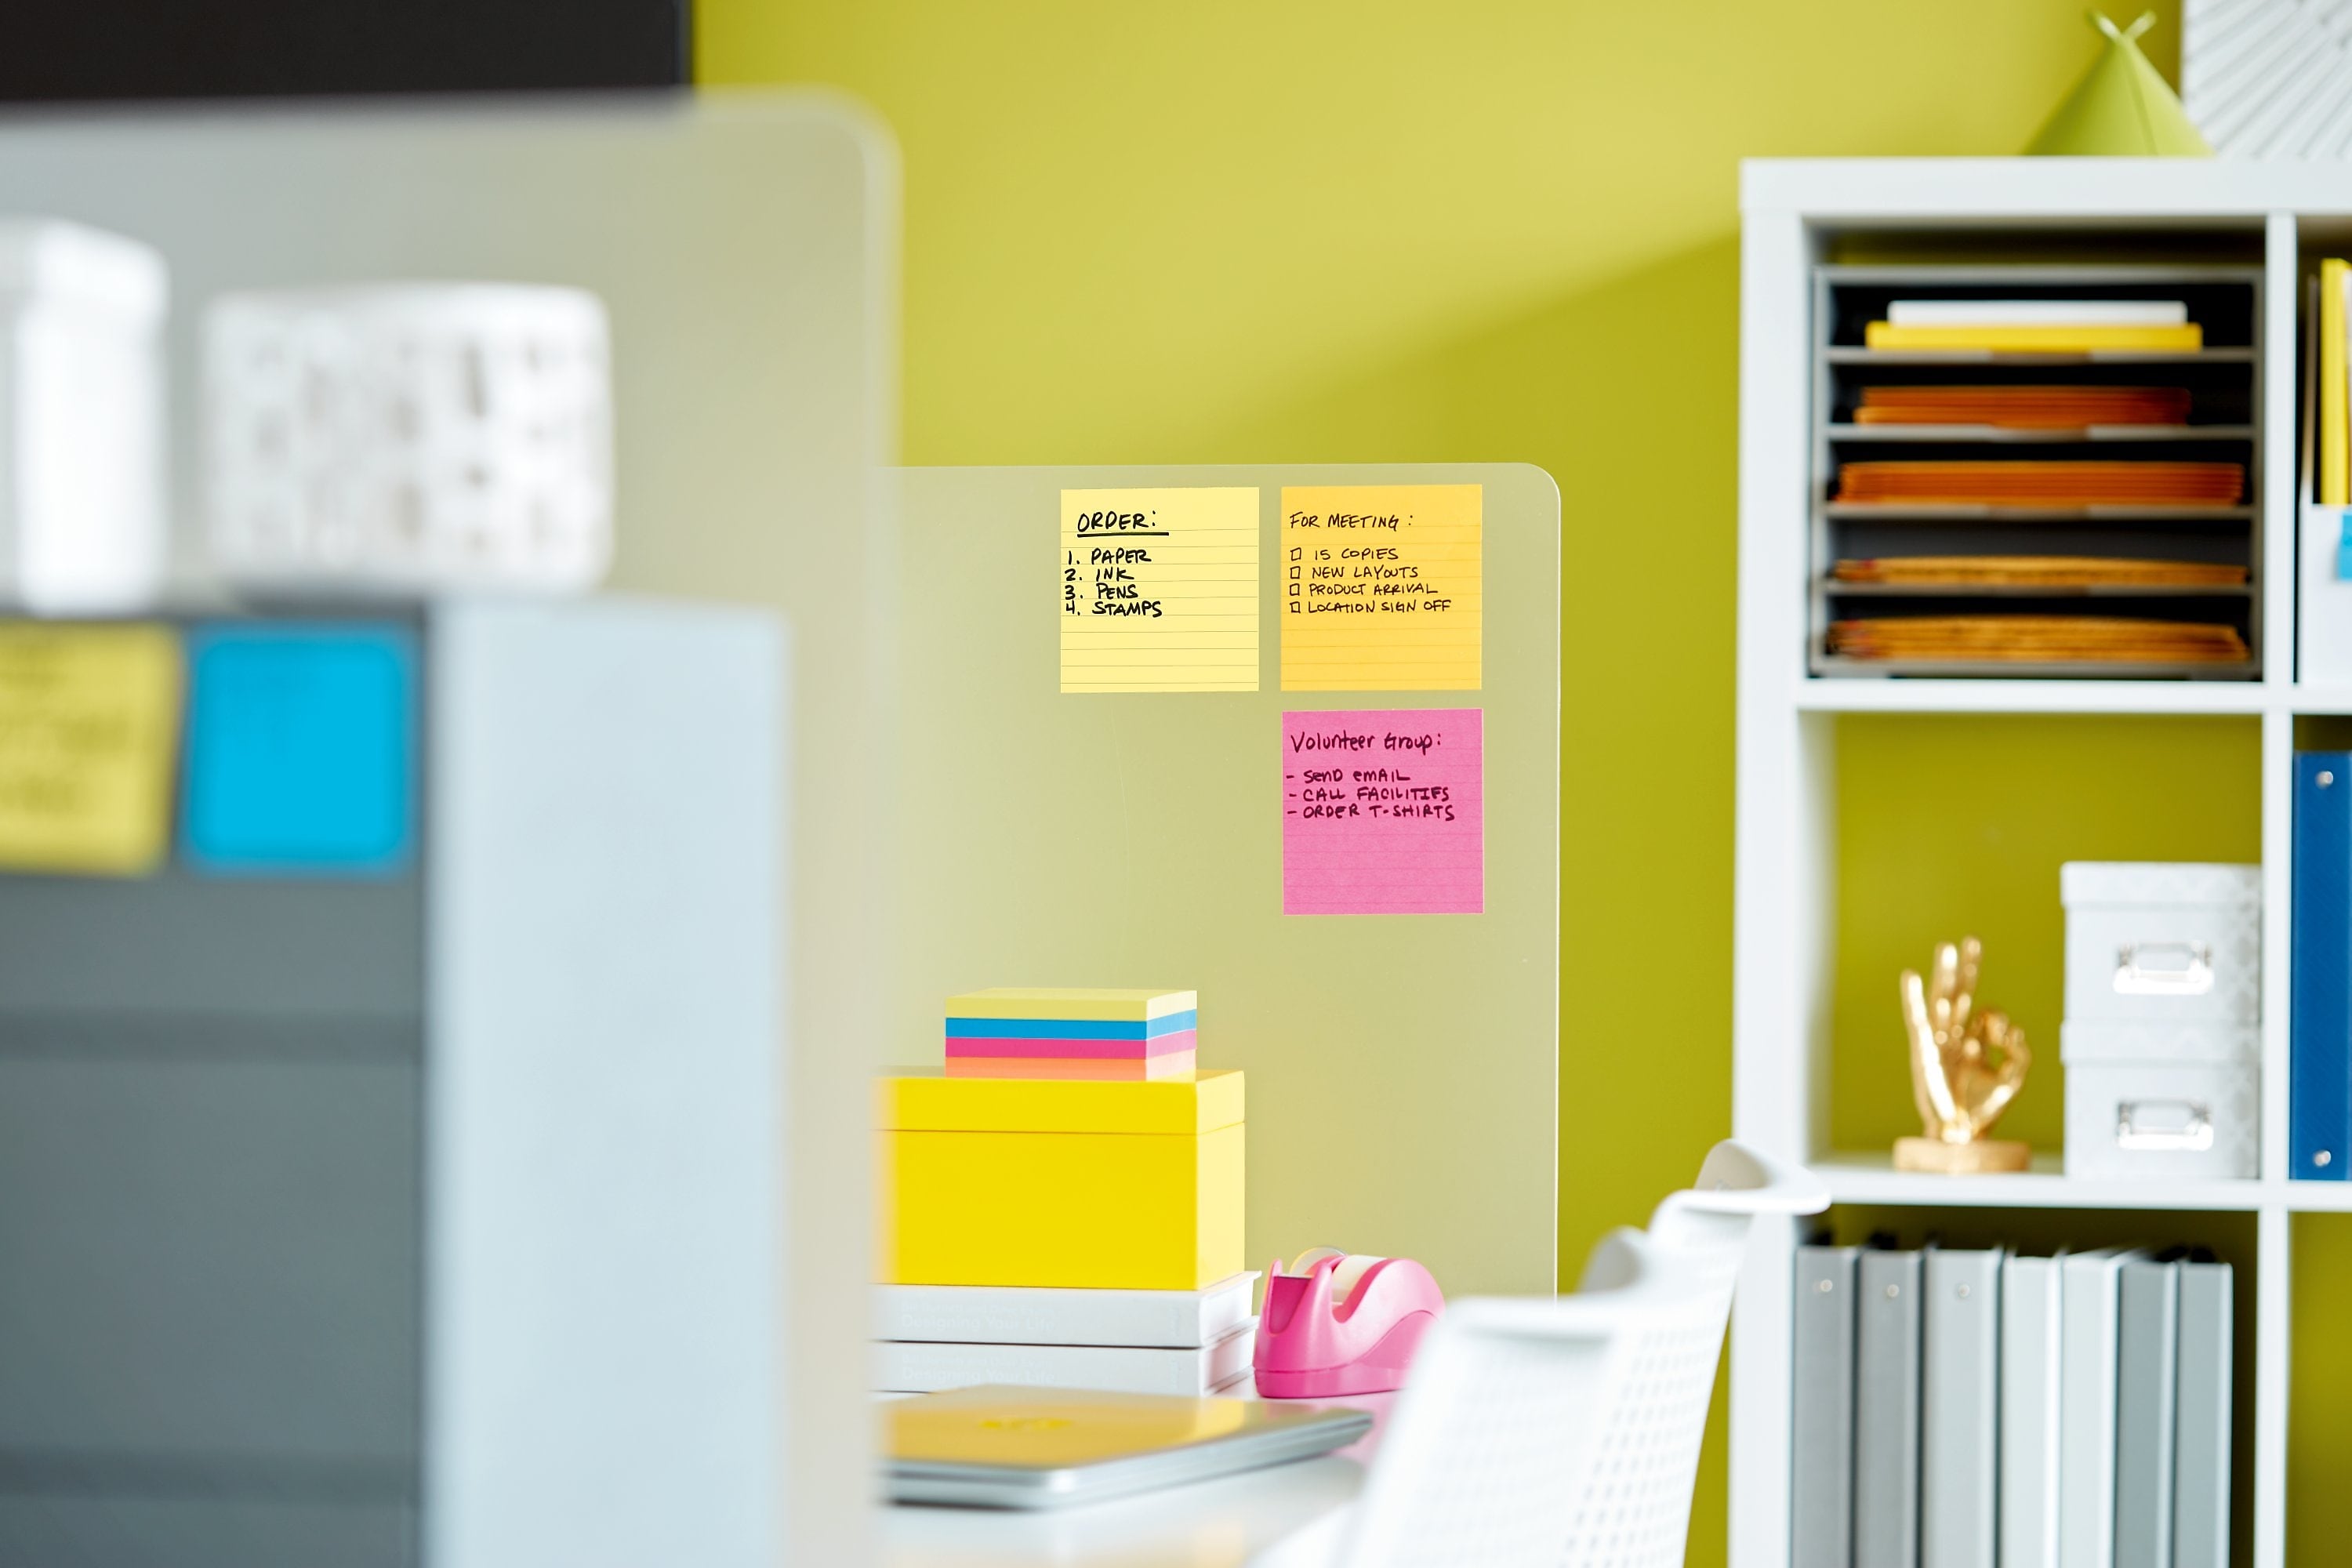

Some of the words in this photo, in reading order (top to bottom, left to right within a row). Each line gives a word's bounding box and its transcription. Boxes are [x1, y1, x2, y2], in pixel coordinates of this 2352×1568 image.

[1077, 510, 1156, 533] ORDER:
[1289, 511, 1320, 529] FOR
[1068, 550, 1080, 565] 1.
[1091, 546, 1152, 565] PAPER
[1315, 549, 1331, 561] 15
[1341, 547, 1399, 561] COPIES
[1064, 568, 1083, 582] 2.
[1095, 566, 1135, 583] INK
[1312, 566, 1345, 579] NEW
[1353, 564, 1418, 580] LAYOUTS
[1064, 584, 1083, 601] 3.
[1095, 582, 1139, 601] PENS
[1308, 583, 1367, 597] PRODUCT
[1374, 583, 1439, 596] ARRIVAL
[1065, 599, 1081, 616] 4.
[1091, 600, 1163, 619] STAMPS
[1308, 600, 1375, 614] LOCATION
[1381, 599, 1417, 613] SIGN
[1423, 599, 1452, 612] OFF
[1290, 729, 1376, 753] Volunteer
[1384, 731, 1441, 756] Group:
[1302, 787, 1346, 802] CALL
[1356, 786, 1450, 803] FACILITIES
[1368, 804, 1455, 822] T-SHIRTS
